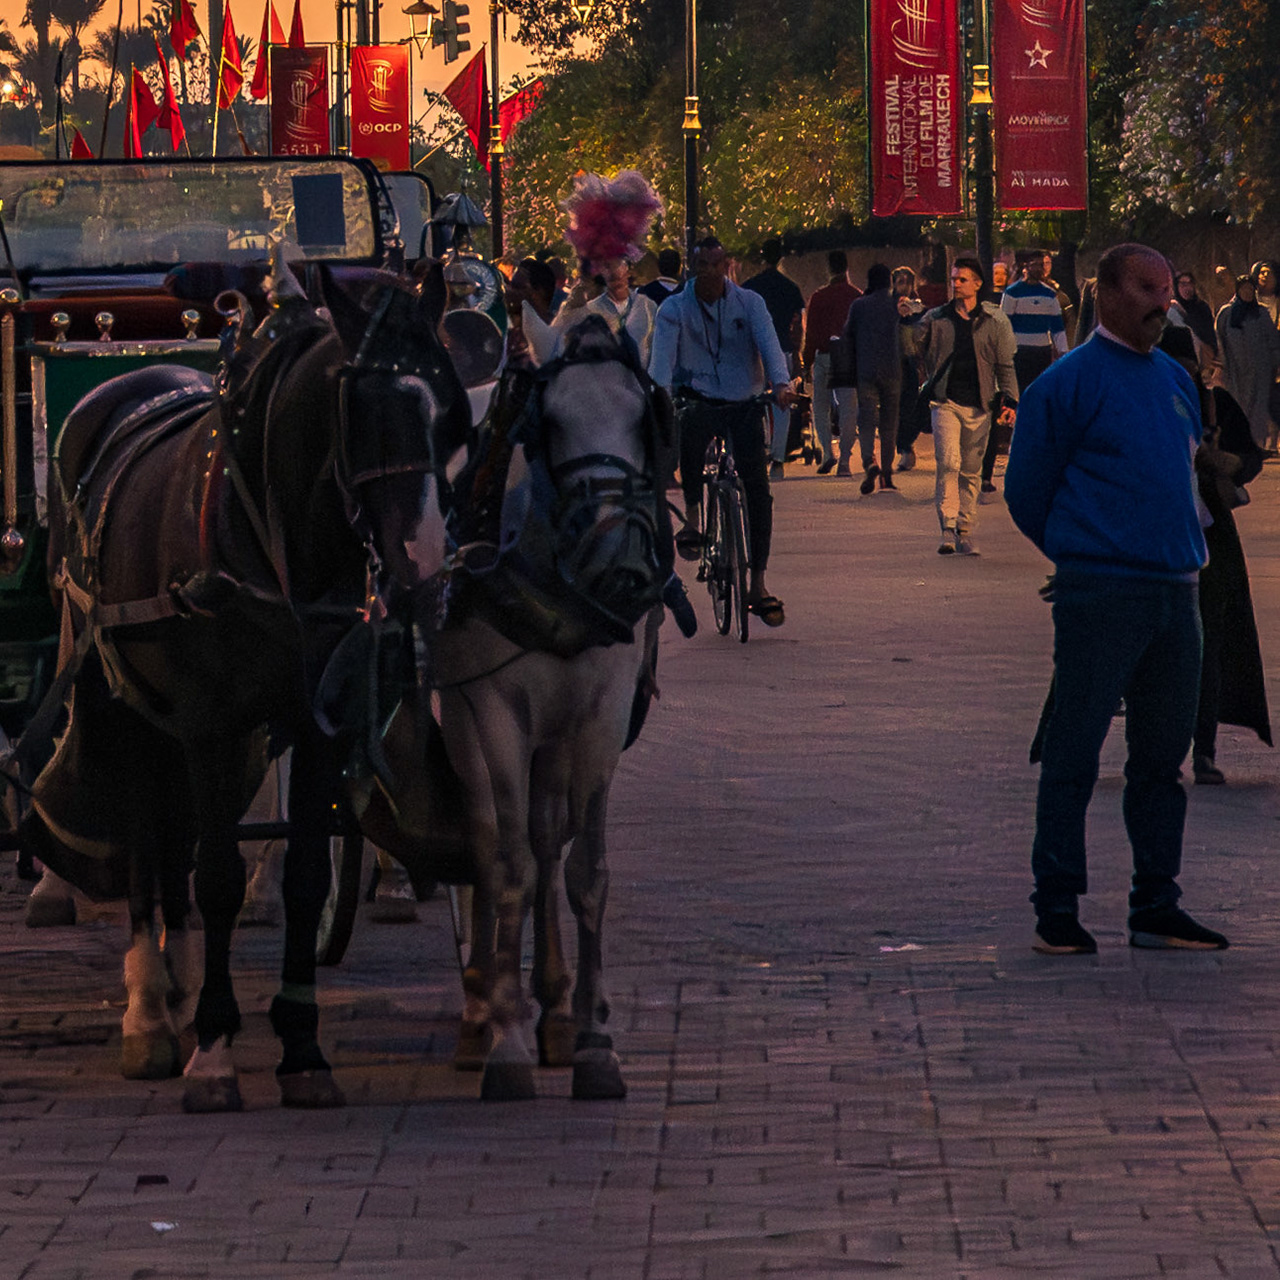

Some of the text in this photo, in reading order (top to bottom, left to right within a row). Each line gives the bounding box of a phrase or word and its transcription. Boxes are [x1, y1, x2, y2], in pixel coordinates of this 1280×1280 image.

[374, 123, 402, 133] OCP
[884, 74, 901, 156] FESTIVAL
[902, 73, 919, 198] INTERNATIONAL
[918, 73, 935, 168] DU FILM DE
[936, 73, 952, 188] MARRAKECH
